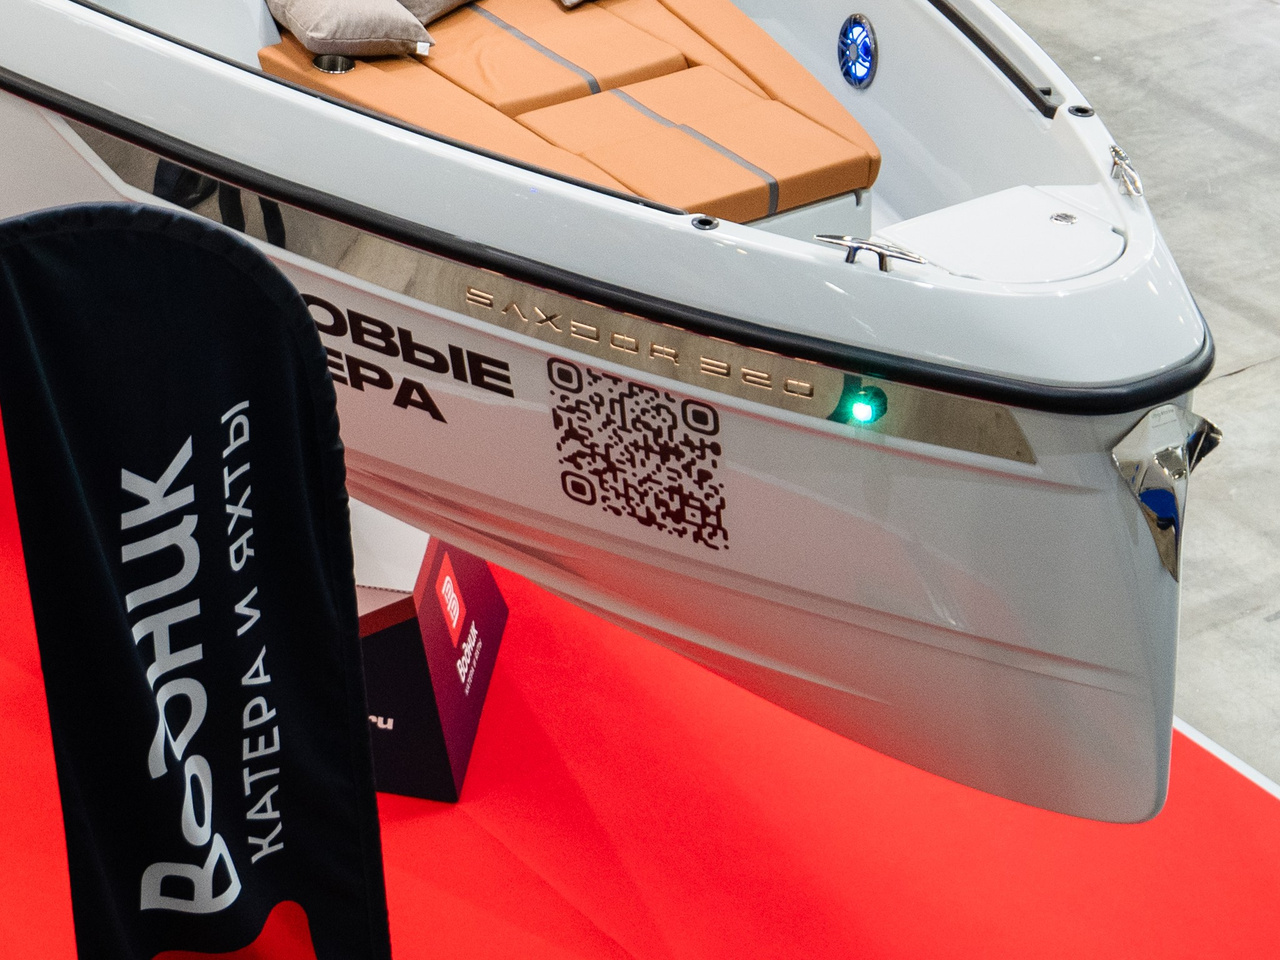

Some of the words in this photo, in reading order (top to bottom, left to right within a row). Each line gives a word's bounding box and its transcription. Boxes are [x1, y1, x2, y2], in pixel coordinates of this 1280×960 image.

[300, 292, 515, 399] ОВЫЕ
[325, 346, 448, 424] ЕРА
[465, 285, 680, 366] SAXDOR
[700, 355, 815, 400] 320
[221, 399, 258, 574] ЯХТЫ
[234, 586, 260, 638] И
[456, 620, 479, 684] Водник
[120, 433, 242, 915] Водник
[242, 644, 285, 864] КАТЕРА
